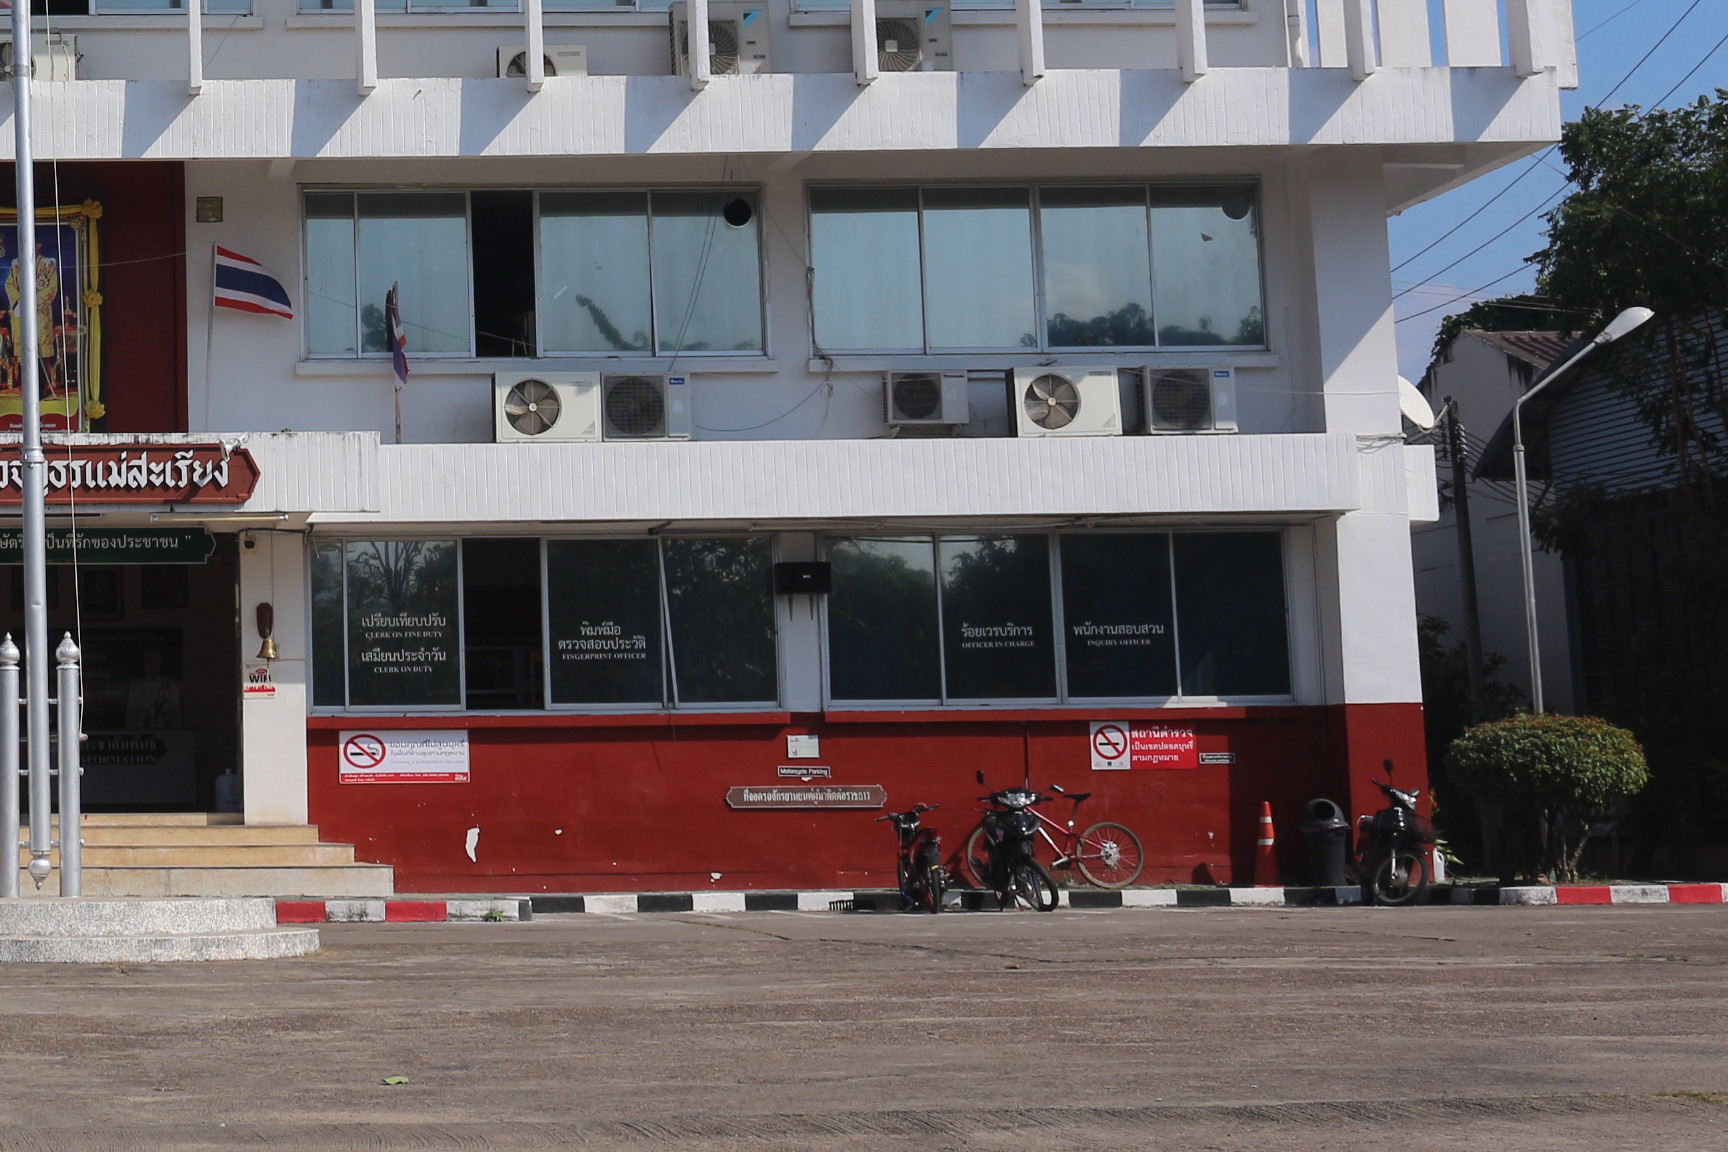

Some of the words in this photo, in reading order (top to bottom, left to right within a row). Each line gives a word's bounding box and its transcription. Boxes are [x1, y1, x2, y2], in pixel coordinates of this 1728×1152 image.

[45, 532, 178, 549] ป็นที่รักของประชาชน
[361, 612, 446, 627] เปรียบเทียบปรับ
[579, 621, 621, 636] พิมพ์มือ
[961, 622, 1033, 637] ร้อยเวรบริการ
[1072, 621, 1164, 636] พนักงานสอบสวน
[558, 635, 646, 649] ตรวจสอบประวัติ
[361, 646, 447, 662] เสมียนประจำวัน
[1130, 726, 1194, 738] สถานีตำรวจ
[80, 755, 158, 764] NFORMATION
